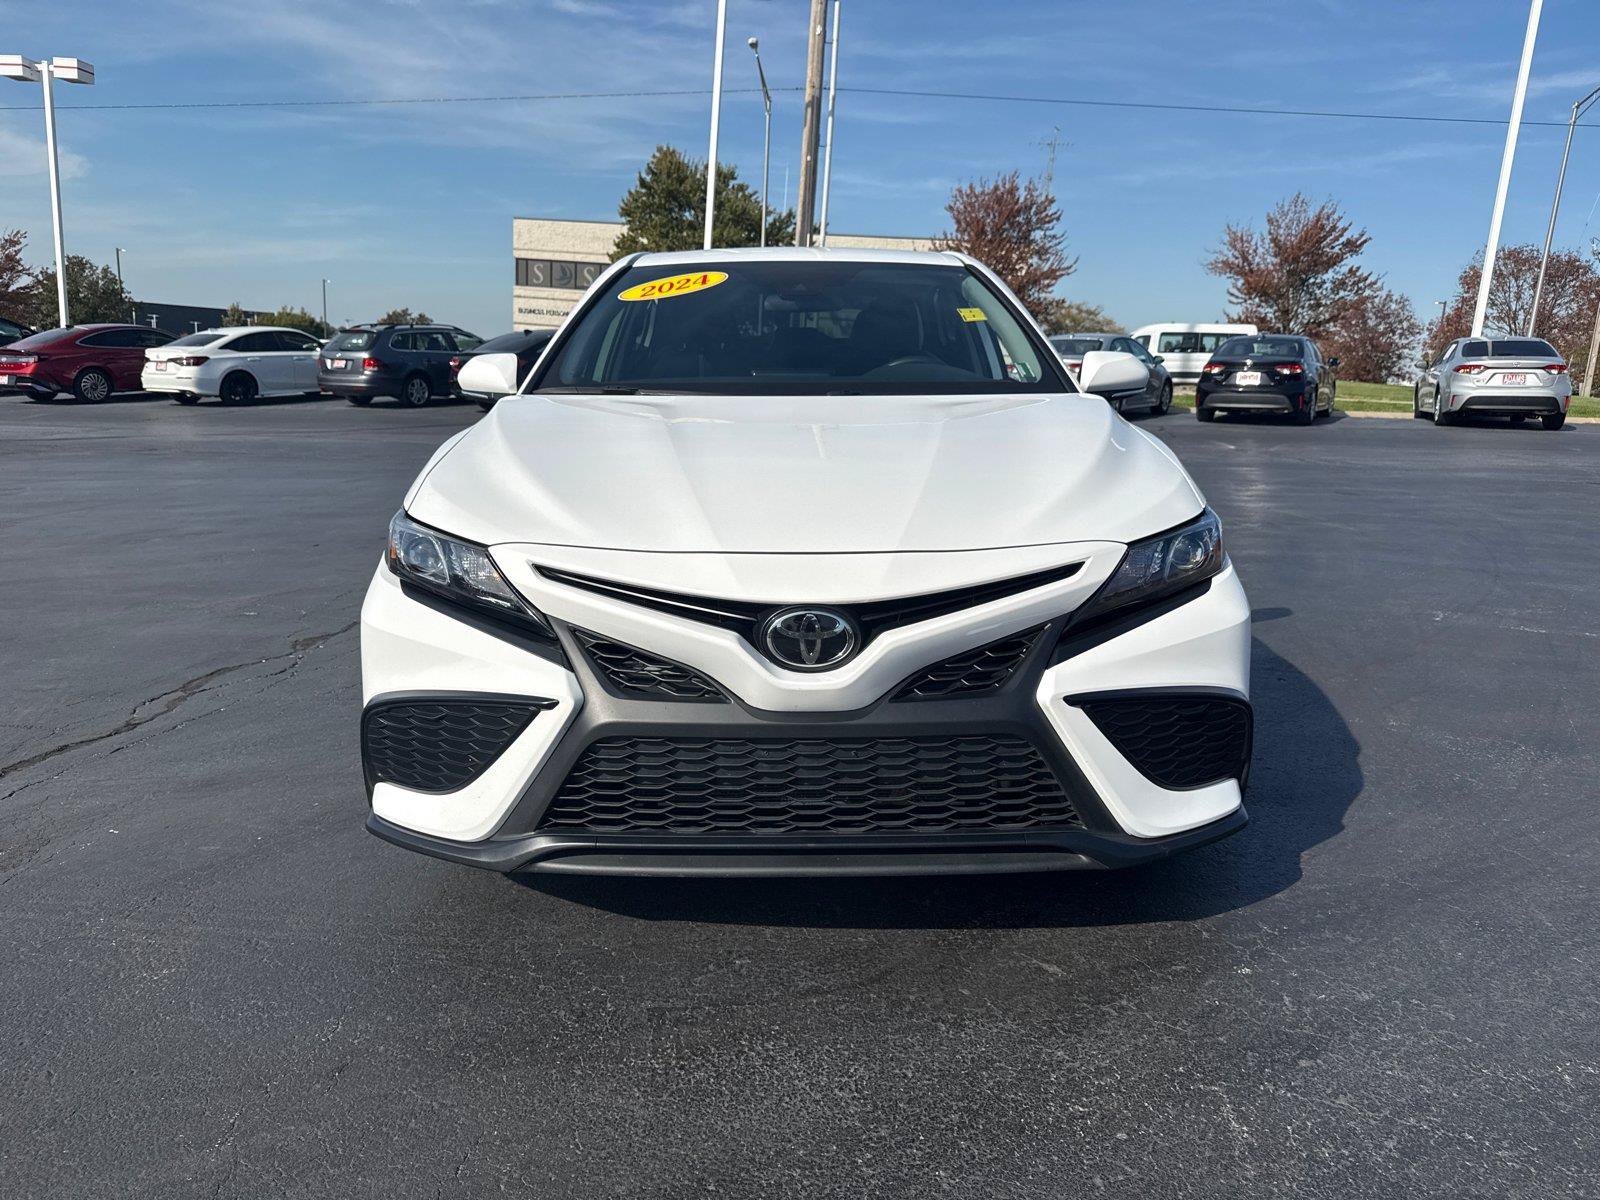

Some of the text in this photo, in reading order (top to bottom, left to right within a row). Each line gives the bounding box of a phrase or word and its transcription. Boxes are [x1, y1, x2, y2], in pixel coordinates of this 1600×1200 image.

[533, 263, 544, 284] S
[640, 274, 709, 298] 2024
[518, 308, 545, 317] BUSINESS
